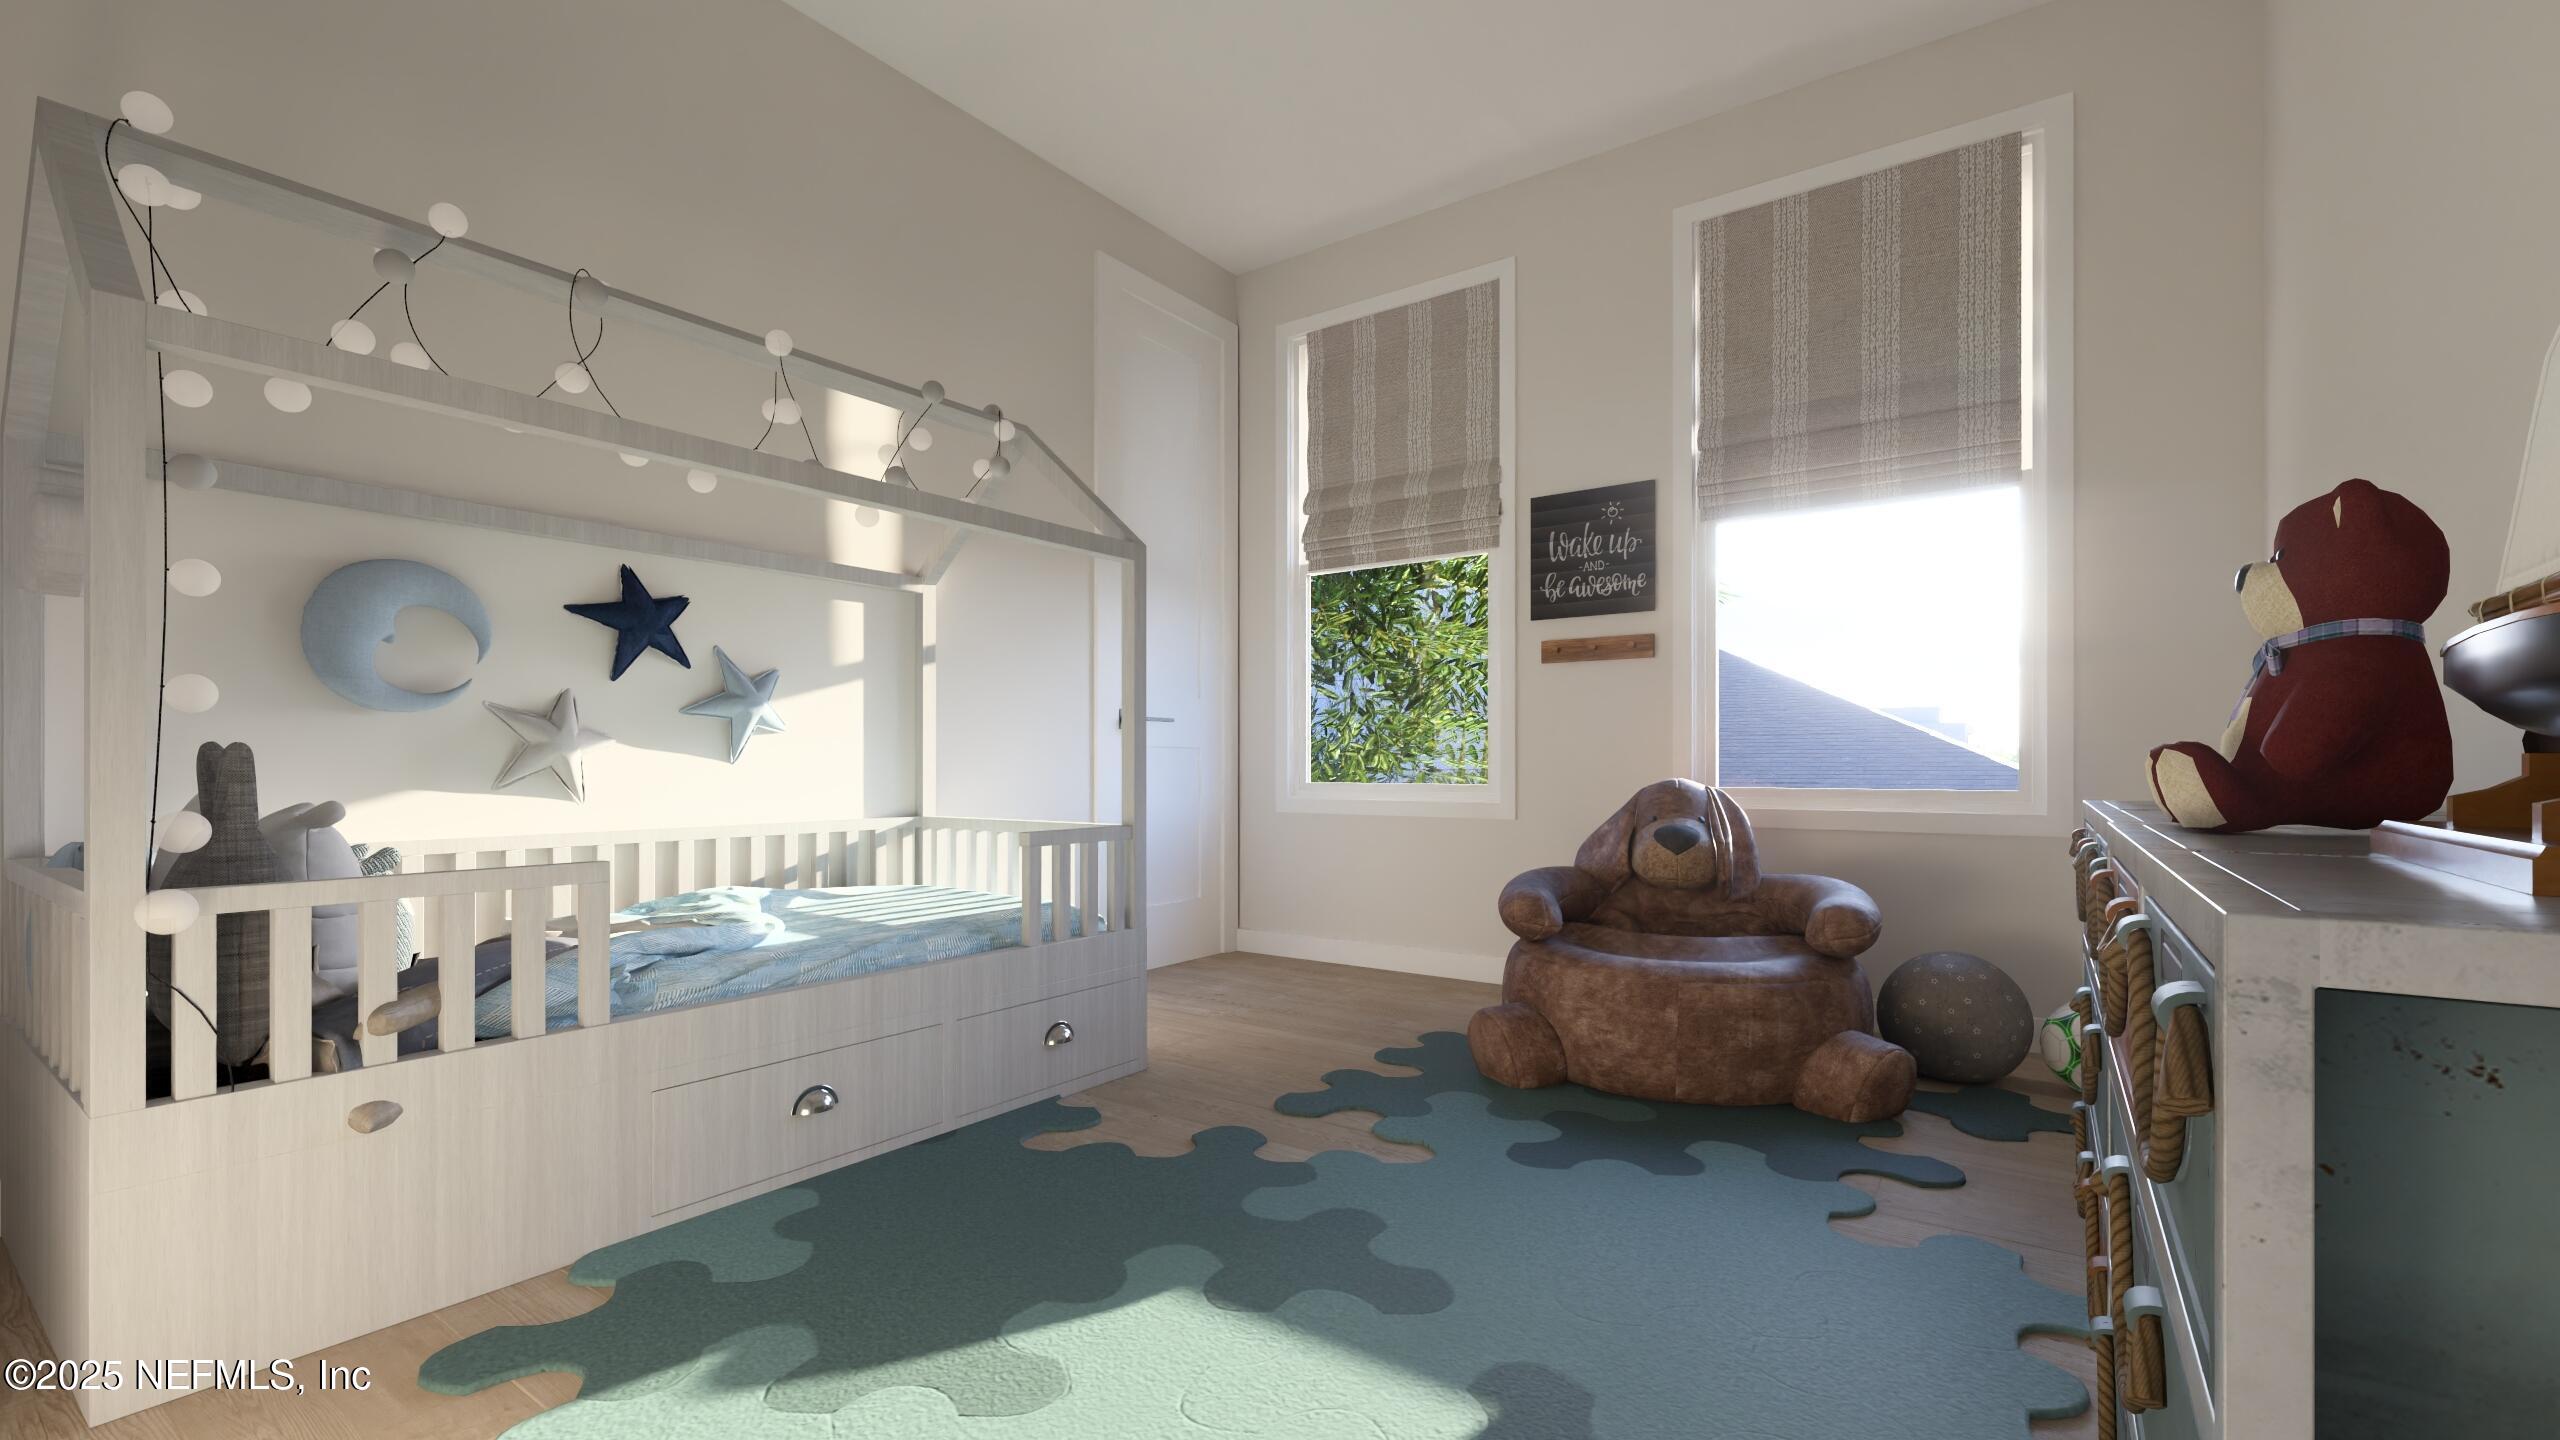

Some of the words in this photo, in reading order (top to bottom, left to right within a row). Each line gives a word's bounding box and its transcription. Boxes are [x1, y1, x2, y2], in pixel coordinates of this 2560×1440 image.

[1549, 522, 1602, 562] Wake
[1609, 528, 1642, 560] up
[1540, 572, 1566, 603] be
[1568, 572, 1647, 597] awesome
